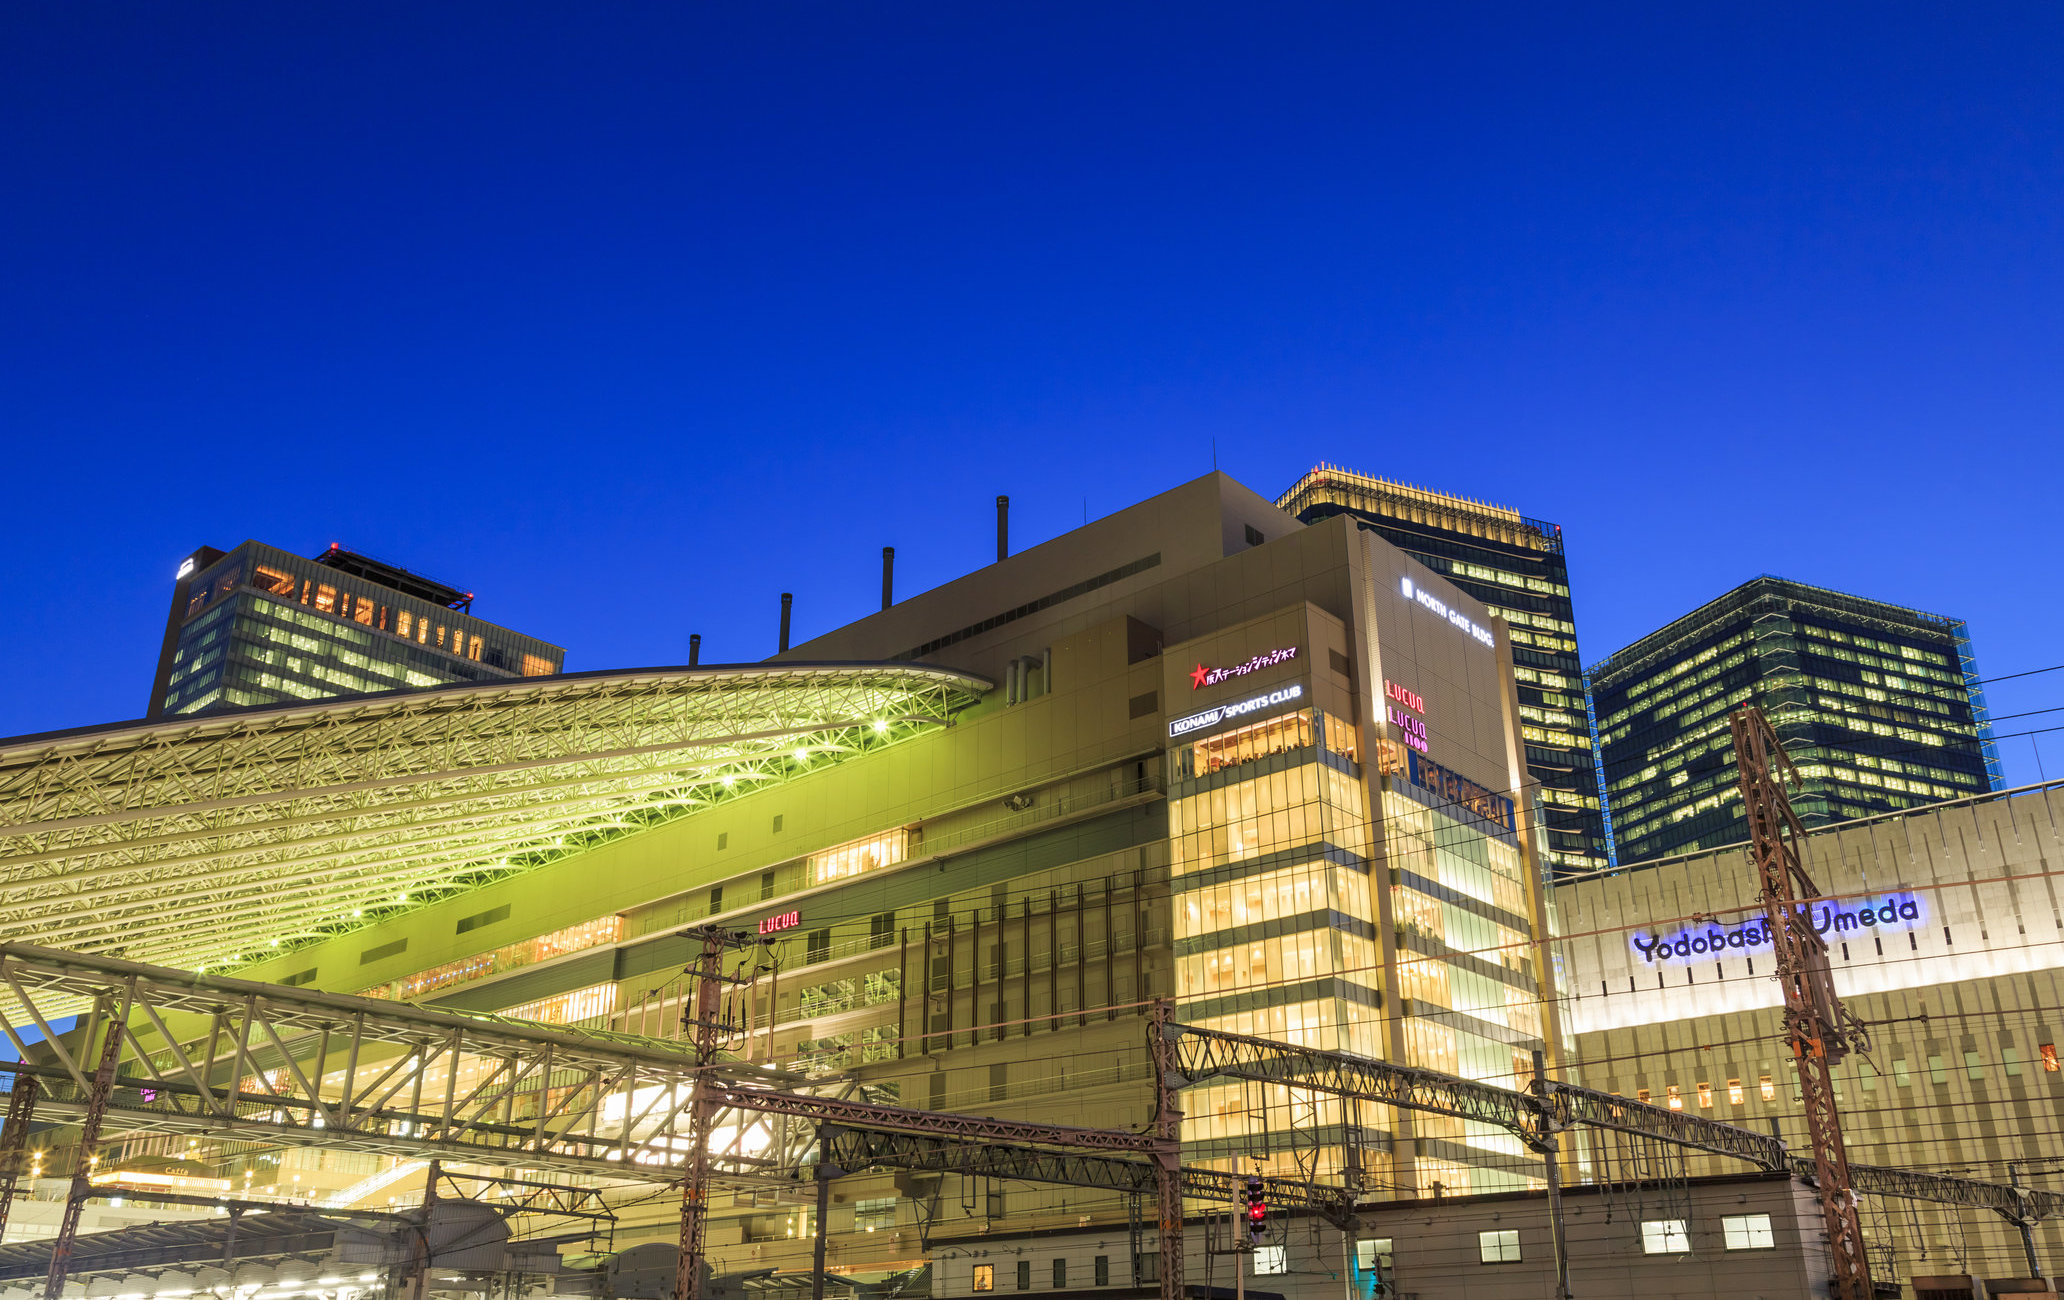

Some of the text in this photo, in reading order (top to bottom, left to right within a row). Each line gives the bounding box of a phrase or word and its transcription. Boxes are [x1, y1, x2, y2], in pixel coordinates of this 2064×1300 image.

[1416, 589, 1447, 618] NORTH
[1448, 610, 1470, 633] GATE
[1173, 686, 1301, 733] KONAMI SPORTS CLUB
[1634, 918, 1775, 962] Yodobash
